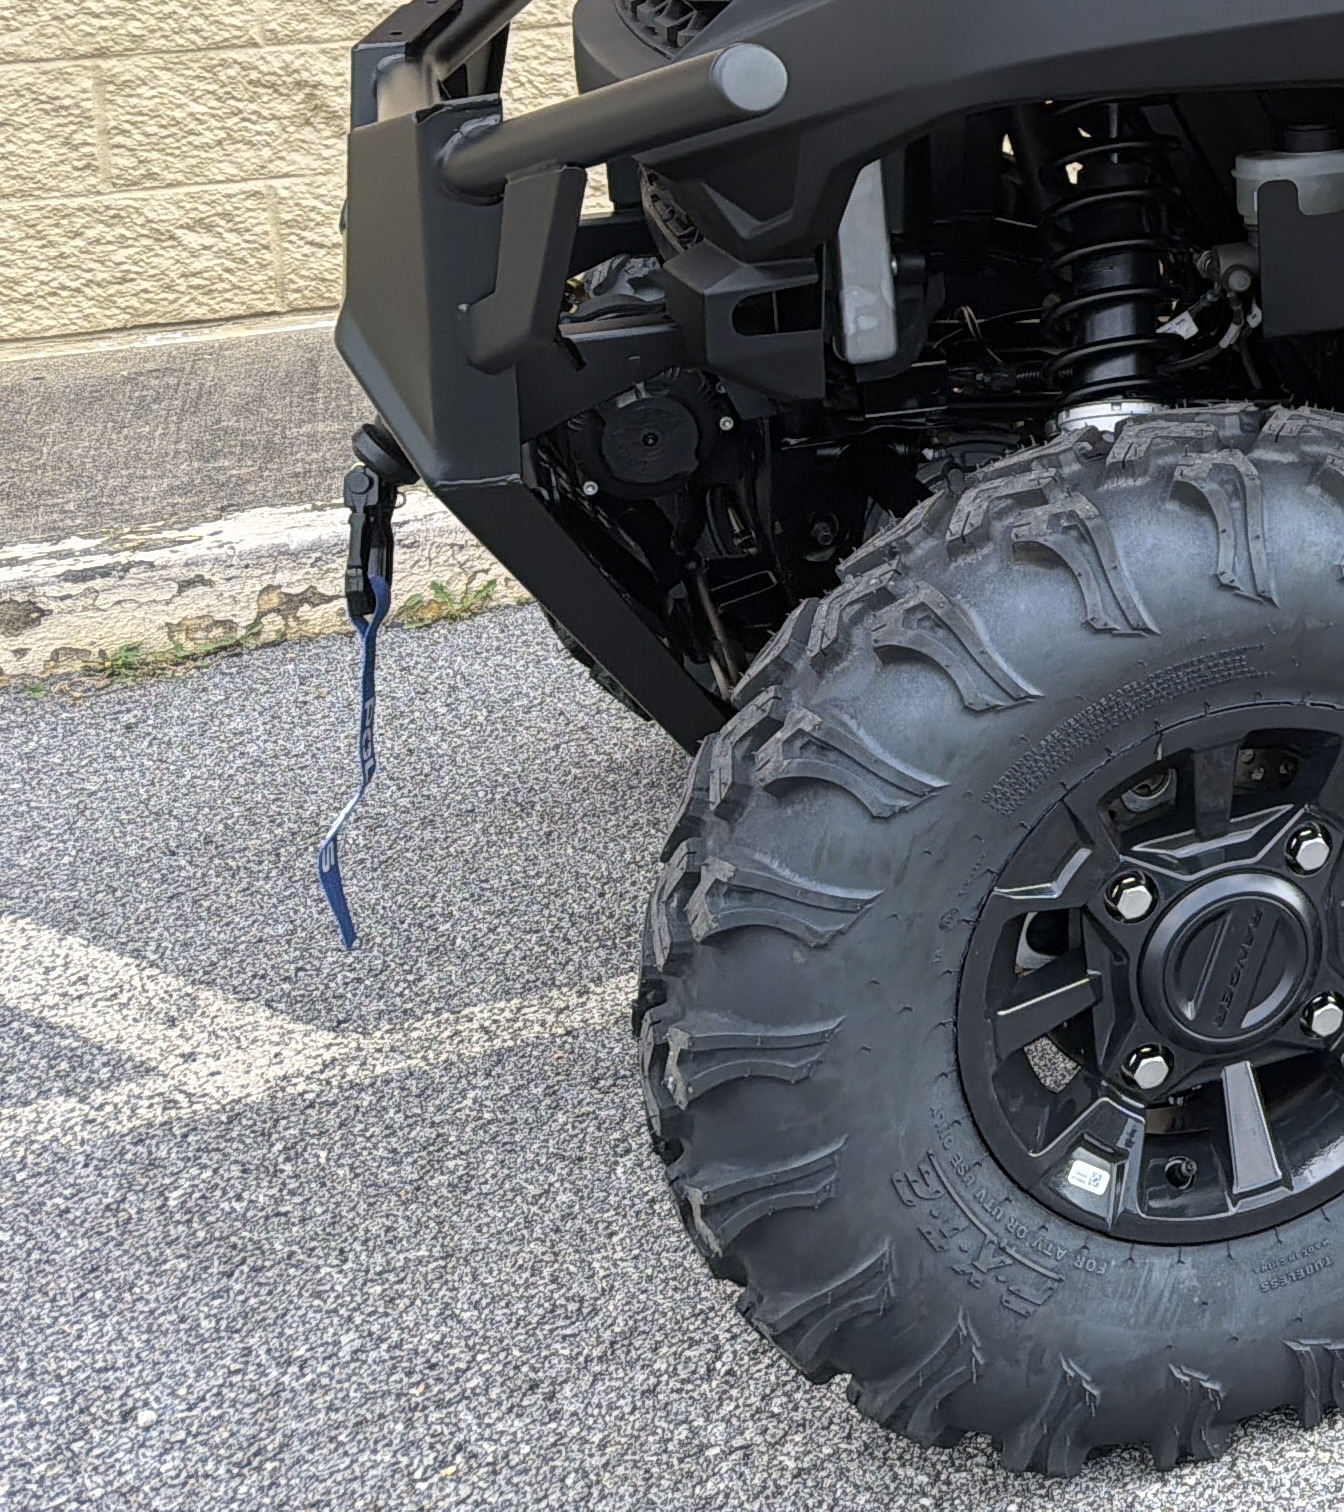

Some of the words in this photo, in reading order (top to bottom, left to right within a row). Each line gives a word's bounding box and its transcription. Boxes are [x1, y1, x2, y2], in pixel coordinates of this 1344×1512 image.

[1212, 907, 1264, 1030] RANGER
[948, 1156, 976, 1188] USE
[974, 1187, 1005, 1218] UTV
[1006, 1217, 1028, 1240] OR
[1030, 1236, 1068, 1261] ATV
[1073, 1256, 1109, 1276] FOR
[1259, 1255, 1335, 1293] TUBELESS
